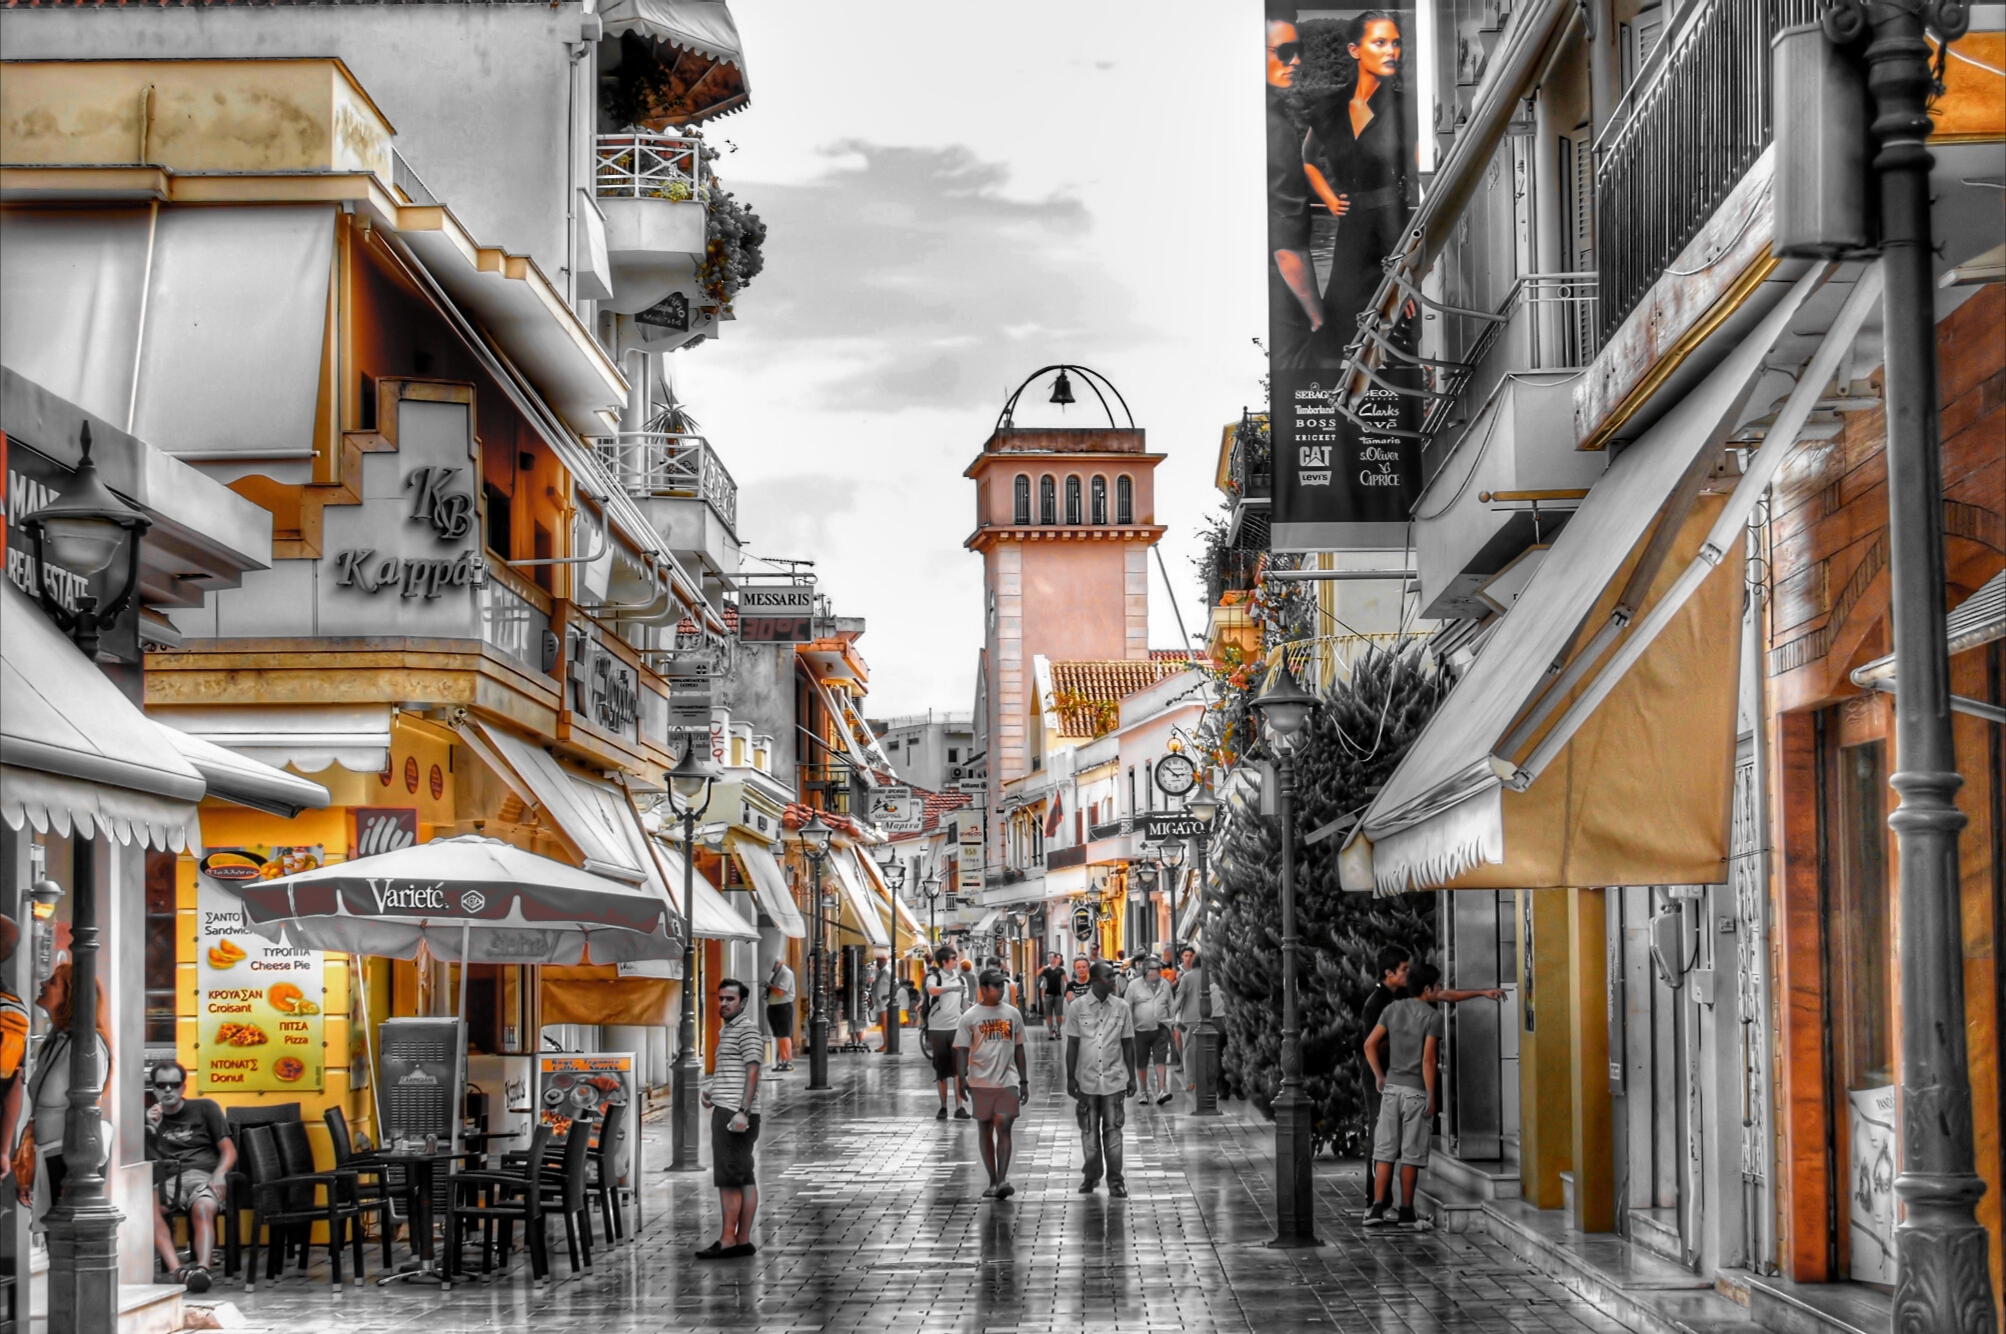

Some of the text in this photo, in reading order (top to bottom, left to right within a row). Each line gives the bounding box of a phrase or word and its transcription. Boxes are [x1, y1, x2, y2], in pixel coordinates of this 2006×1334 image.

[1294, 405, 1335, 415] Timberland
[1358, 402, 1400, 416] Clarks
[1295, 419, 1336, 428] BOSS
[1299, 446, 1332, 467] CAT
[8, 547, 89, 612] REAL ESTATE
[743, 593, 810, 606] MESSARIS
[359, 815, 414, 854] illy
[1149, 821, 1206, 836] MIGATO
[366, 878, 445, 915] Varieté
[205, 912, 242, 924] ΣΑΝΤΟ
[205, 925, 254, 936] Sandwic
[250, 960, 311, 971] Cheese Pie
[208, 989, 263, 1002] ΚΡΟΥΑΣΑΝ
[208, 1003, 252, 1013] Croisant
[279, 1021, 308, 1031] ΠΙΤΣΑ
[284, 1035, 308, 1045] Pizza
[211, 1059, 258, 1071] ΝΤΟΝΑΤΣ
[211, 1073, 244, 1083] Donut
